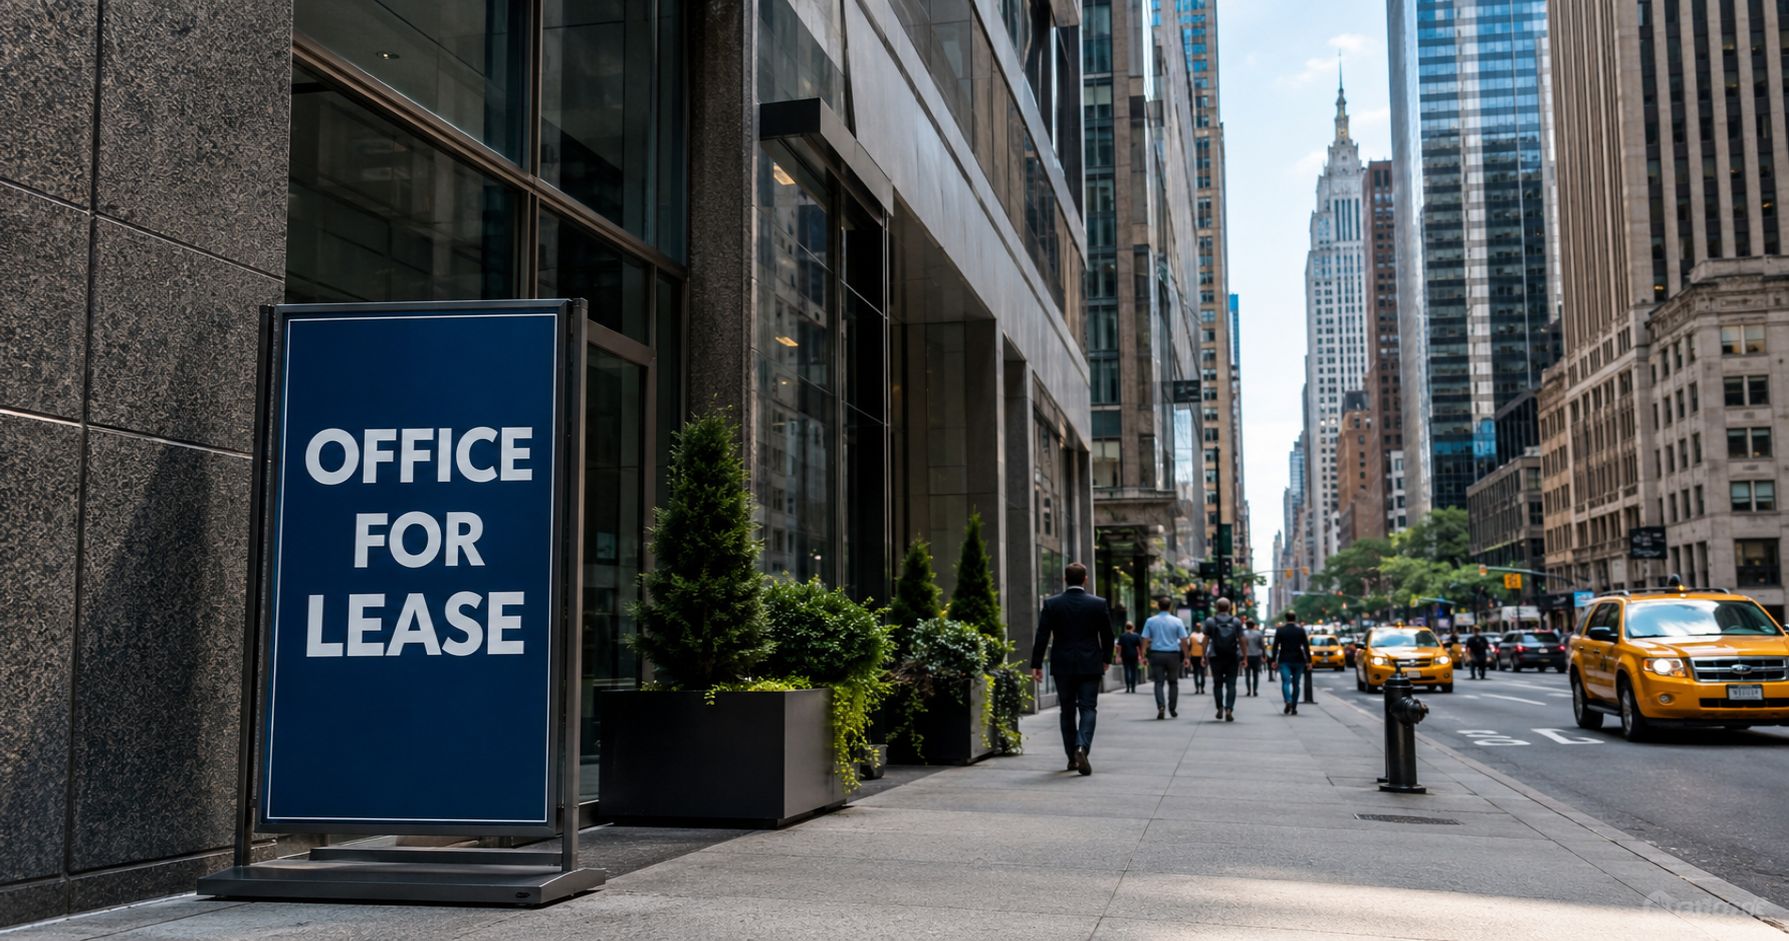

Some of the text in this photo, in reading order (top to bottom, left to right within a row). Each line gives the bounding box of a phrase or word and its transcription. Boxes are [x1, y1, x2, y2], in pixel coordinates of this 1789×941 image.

[305, 427, 533, 486] OFFICE
[354, 511, 486, 568] FOR
[306, 591, 525, 657] LEASE
